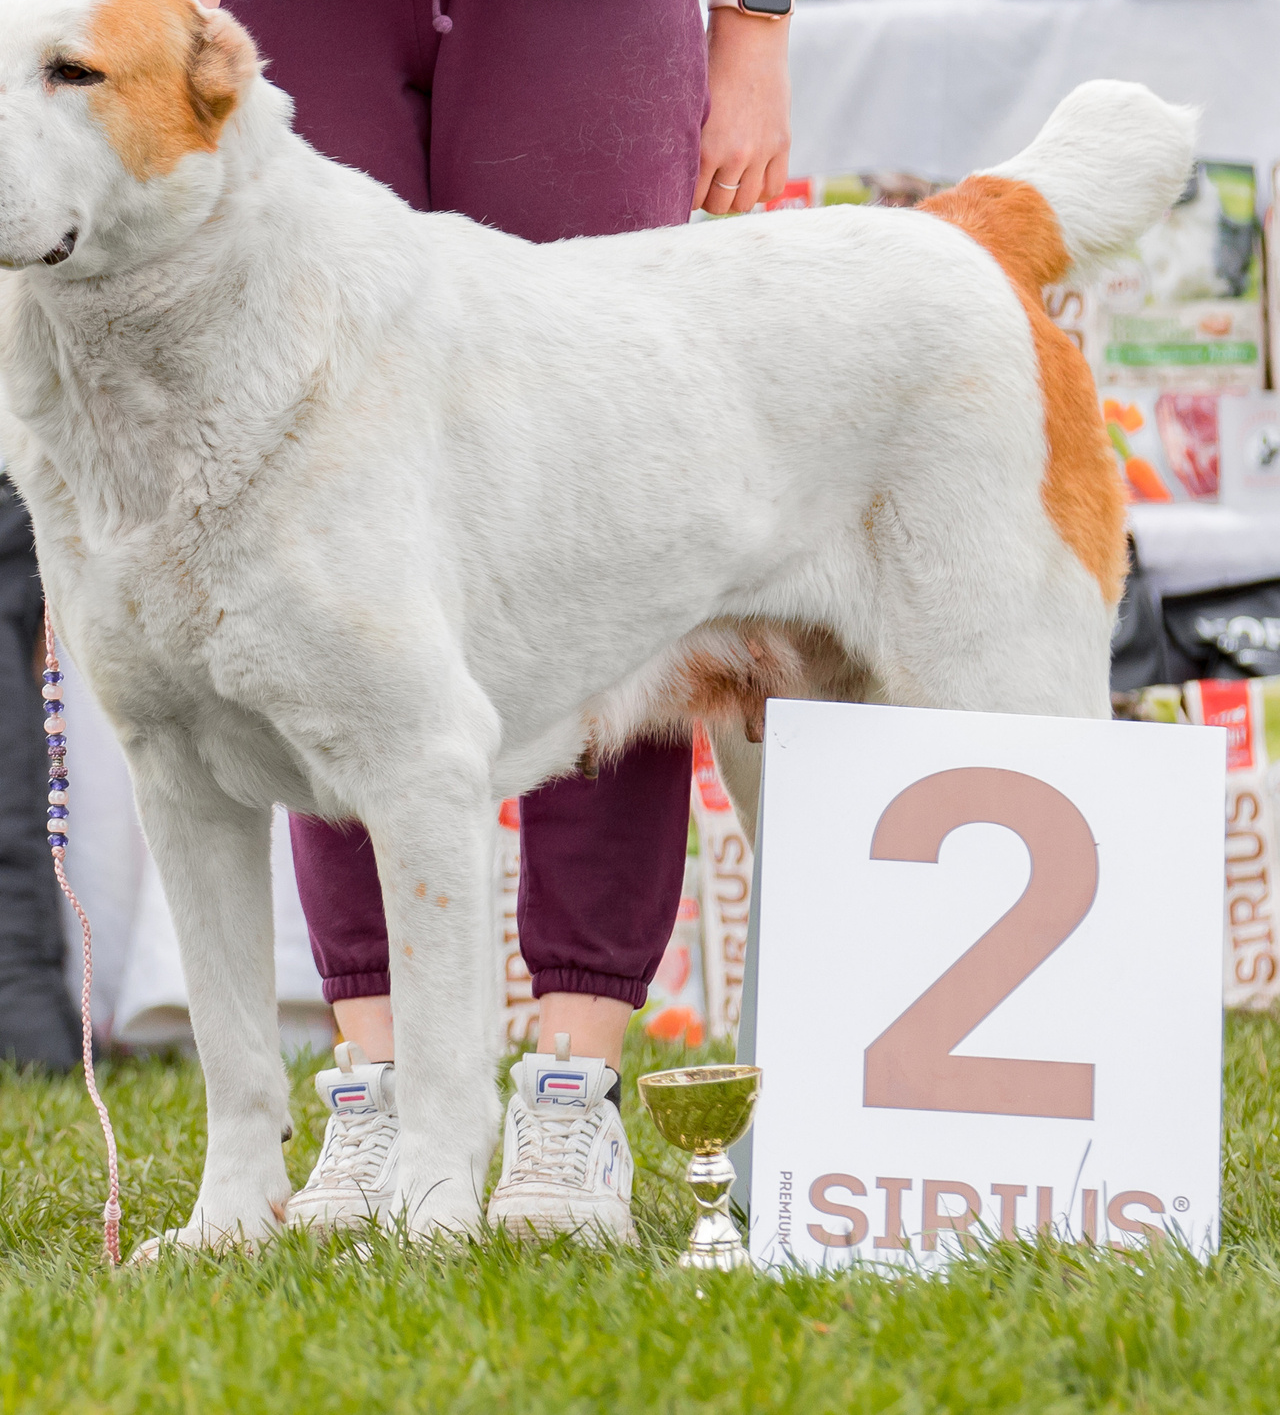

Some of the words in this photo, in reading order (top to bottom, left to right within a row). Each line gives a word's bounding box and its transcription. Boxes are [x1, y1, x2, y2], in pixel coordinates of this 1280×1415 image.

[863, 766, 1099, 1121] 2
[536, 1097, 586, 1107] FILA
[779, 1171, 793, 1245] PREMIUM
